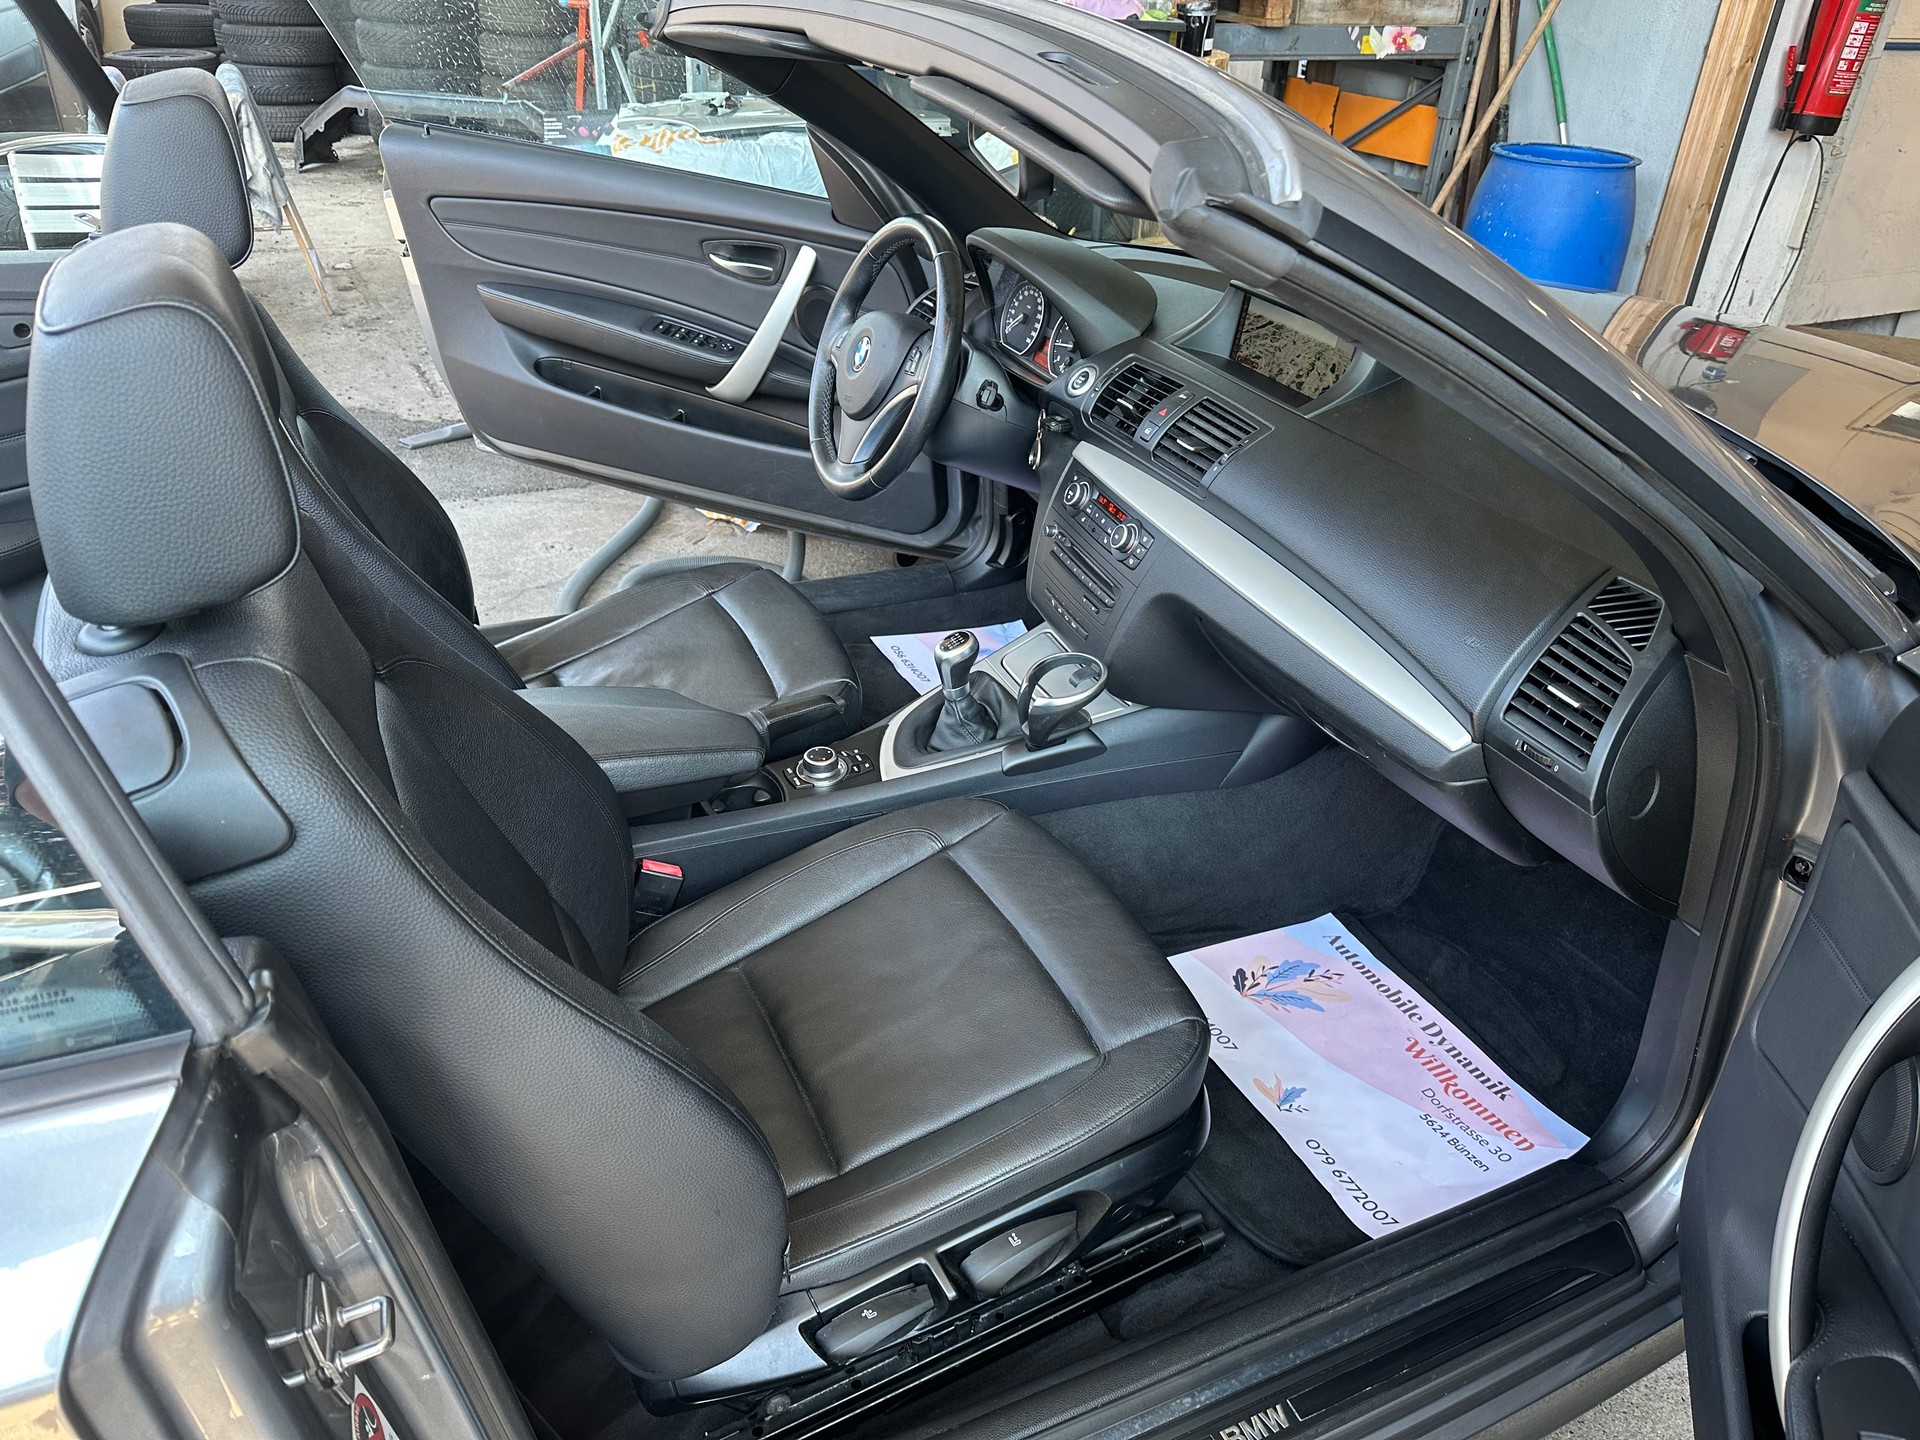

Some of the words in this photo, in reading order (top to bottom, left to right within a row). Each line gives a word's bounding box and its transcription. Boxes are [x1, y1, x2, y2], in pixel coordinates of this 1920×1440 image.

[1209, 1023, 1240, 1050] 007
[1321, 934, 1424, 1024] Automobile
[1420, 1021, 1514, 1102] Dynamik
[1404, 1036, 1535, 1152] Willkommen
[1421, 1087, 1490, 1147] Dorfstrasse
[1488, 1146, 1513, 1163] 30
[1419, 1112, 1451, 1139] 5624
[1446, 1137, 1490, 1173] Bünzen
[1305, 1139, 1336, 1165] 079
[1332, 1169, 1400, 1226] 6772007
[1219, 1403, 1290, 1440] BMW
